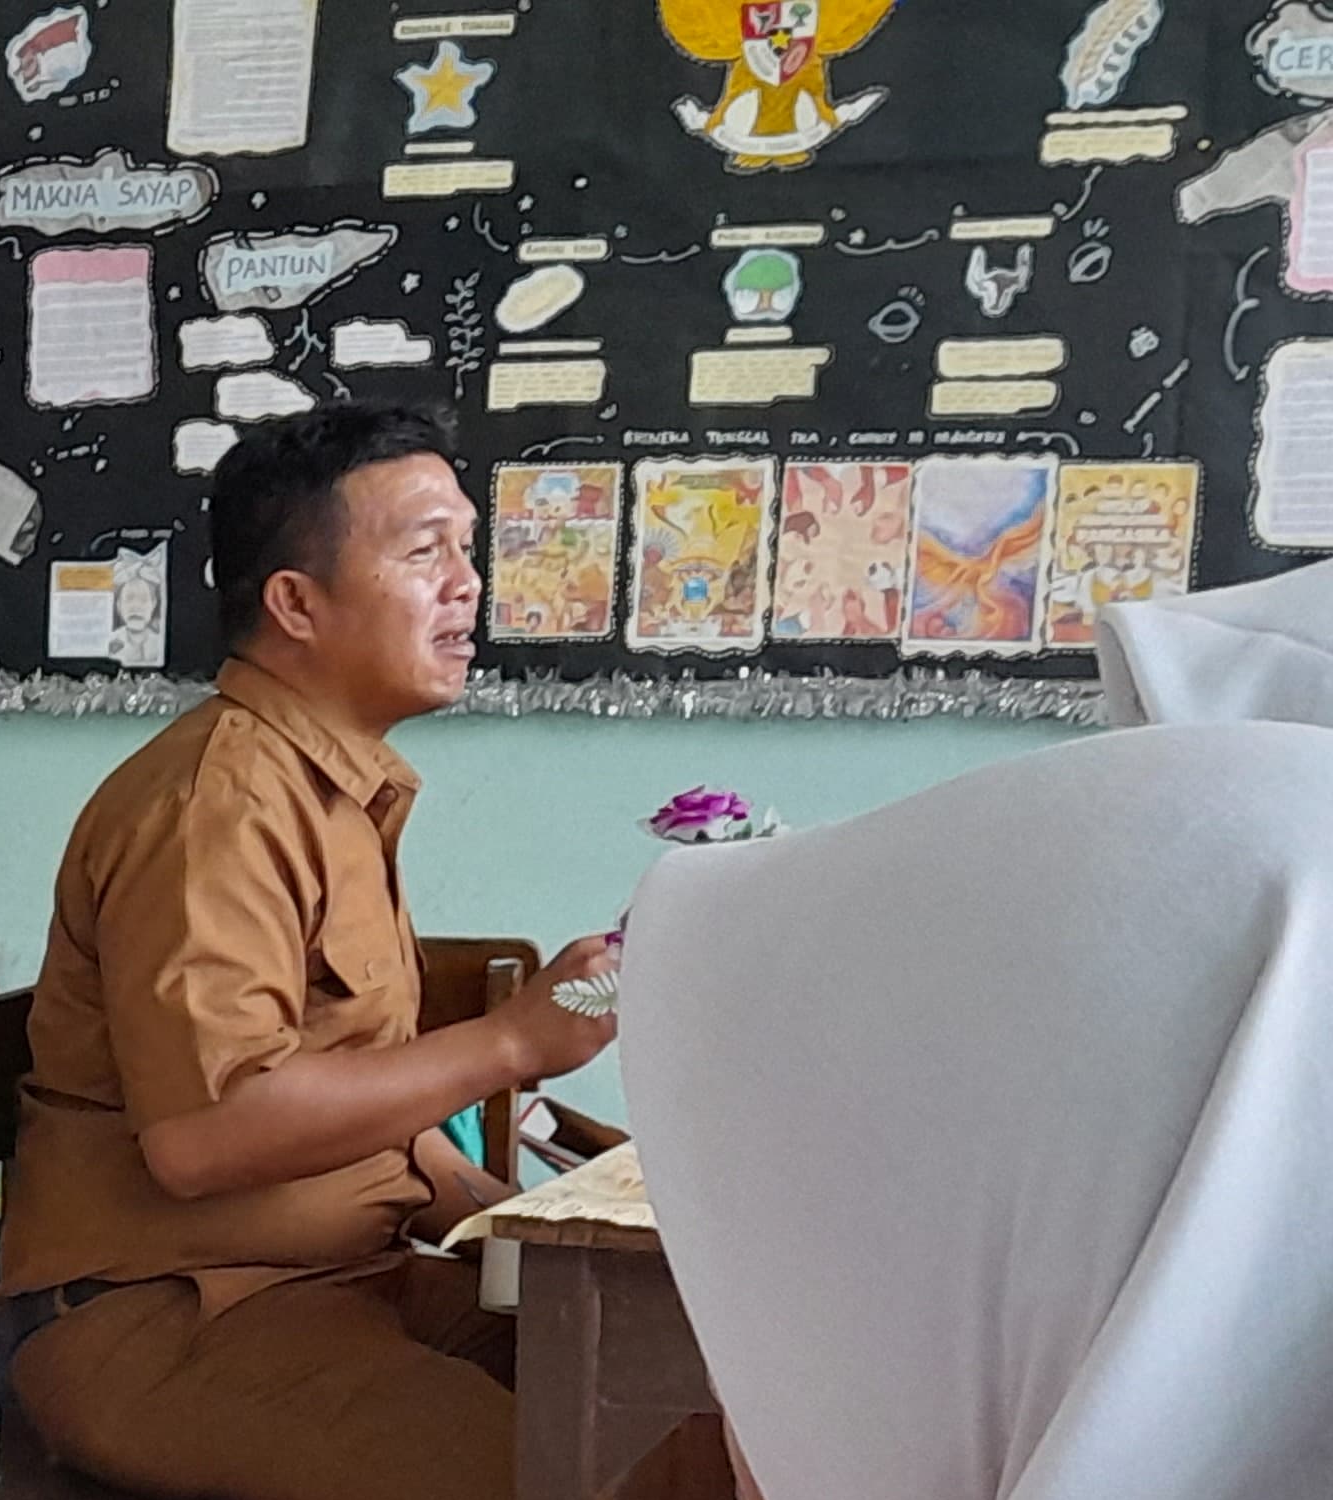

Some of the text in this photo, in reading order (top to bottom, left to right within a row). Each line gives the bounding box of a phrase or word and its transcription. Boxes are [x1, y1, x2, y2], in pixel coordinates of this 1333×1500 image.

[11, 178, 193, 211] MAKNA SAYAP
[226, 252, 326, 289] PANTUN
